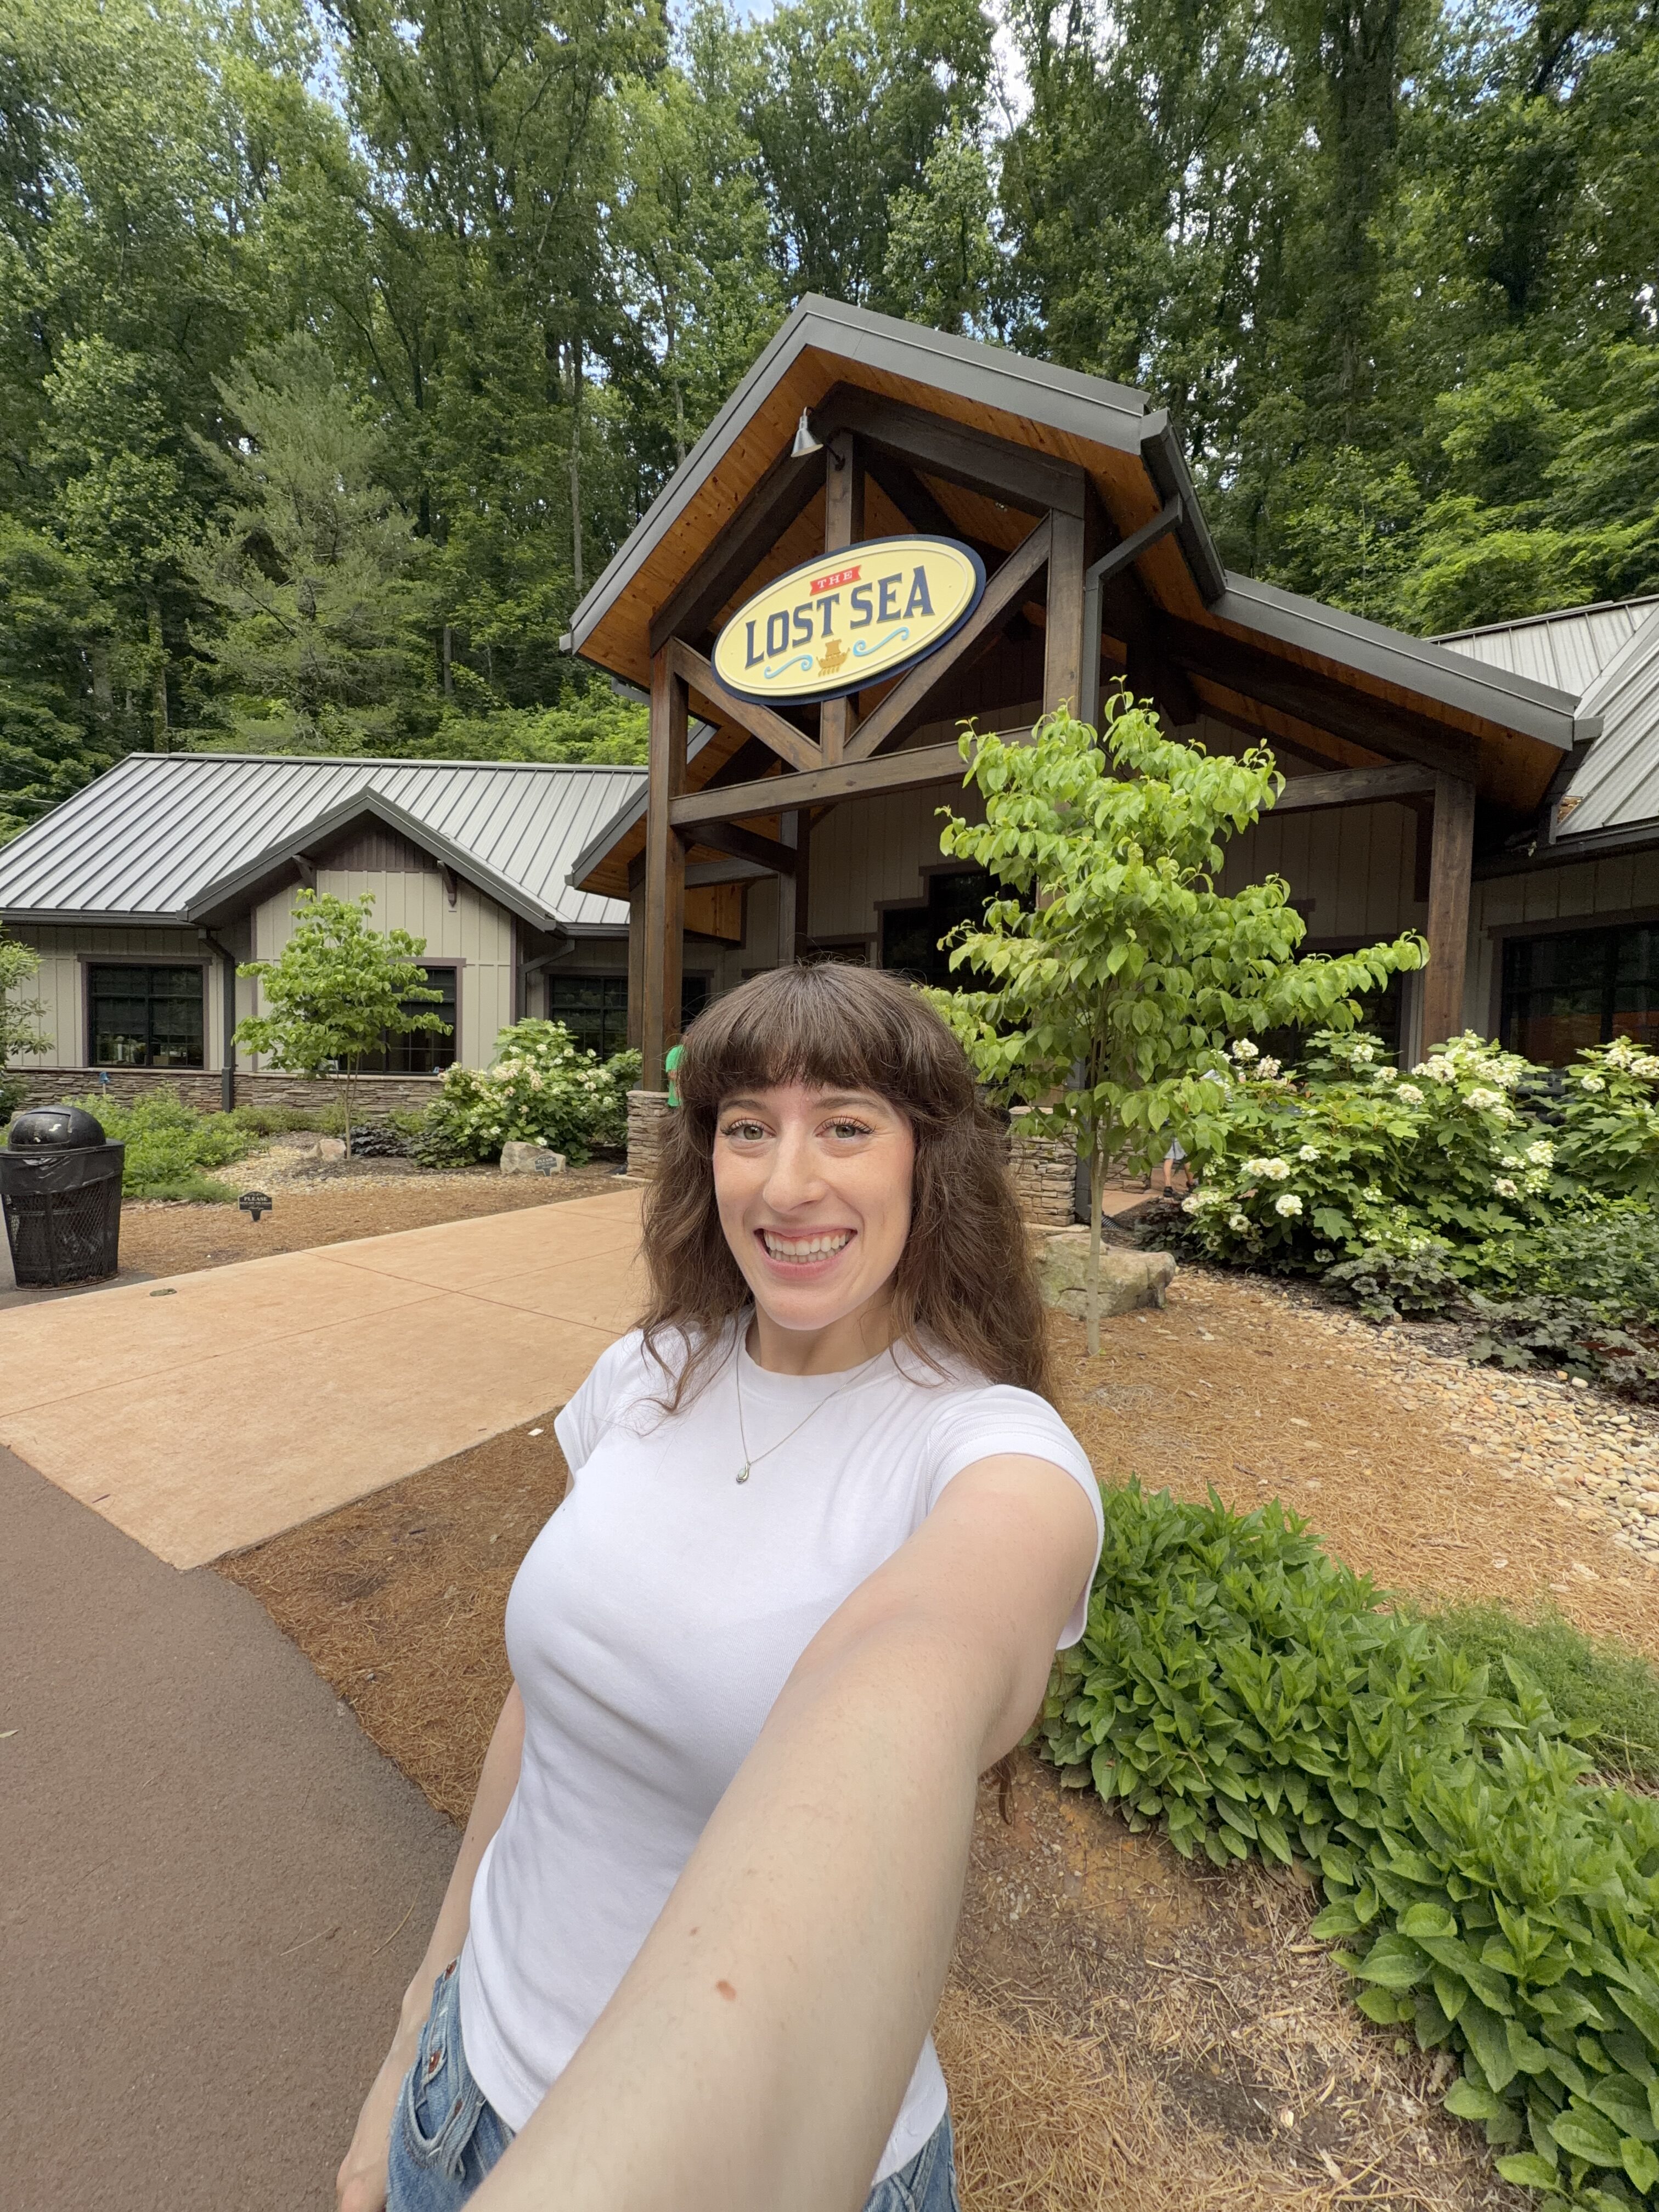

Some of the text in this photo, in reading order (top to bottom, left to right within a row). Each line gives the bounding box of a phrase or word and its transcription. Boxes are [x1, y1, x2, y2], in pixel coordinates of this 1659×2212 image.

[817, 570, 853, 589] THE
[745, 565, 935, 670] LOST SEA
